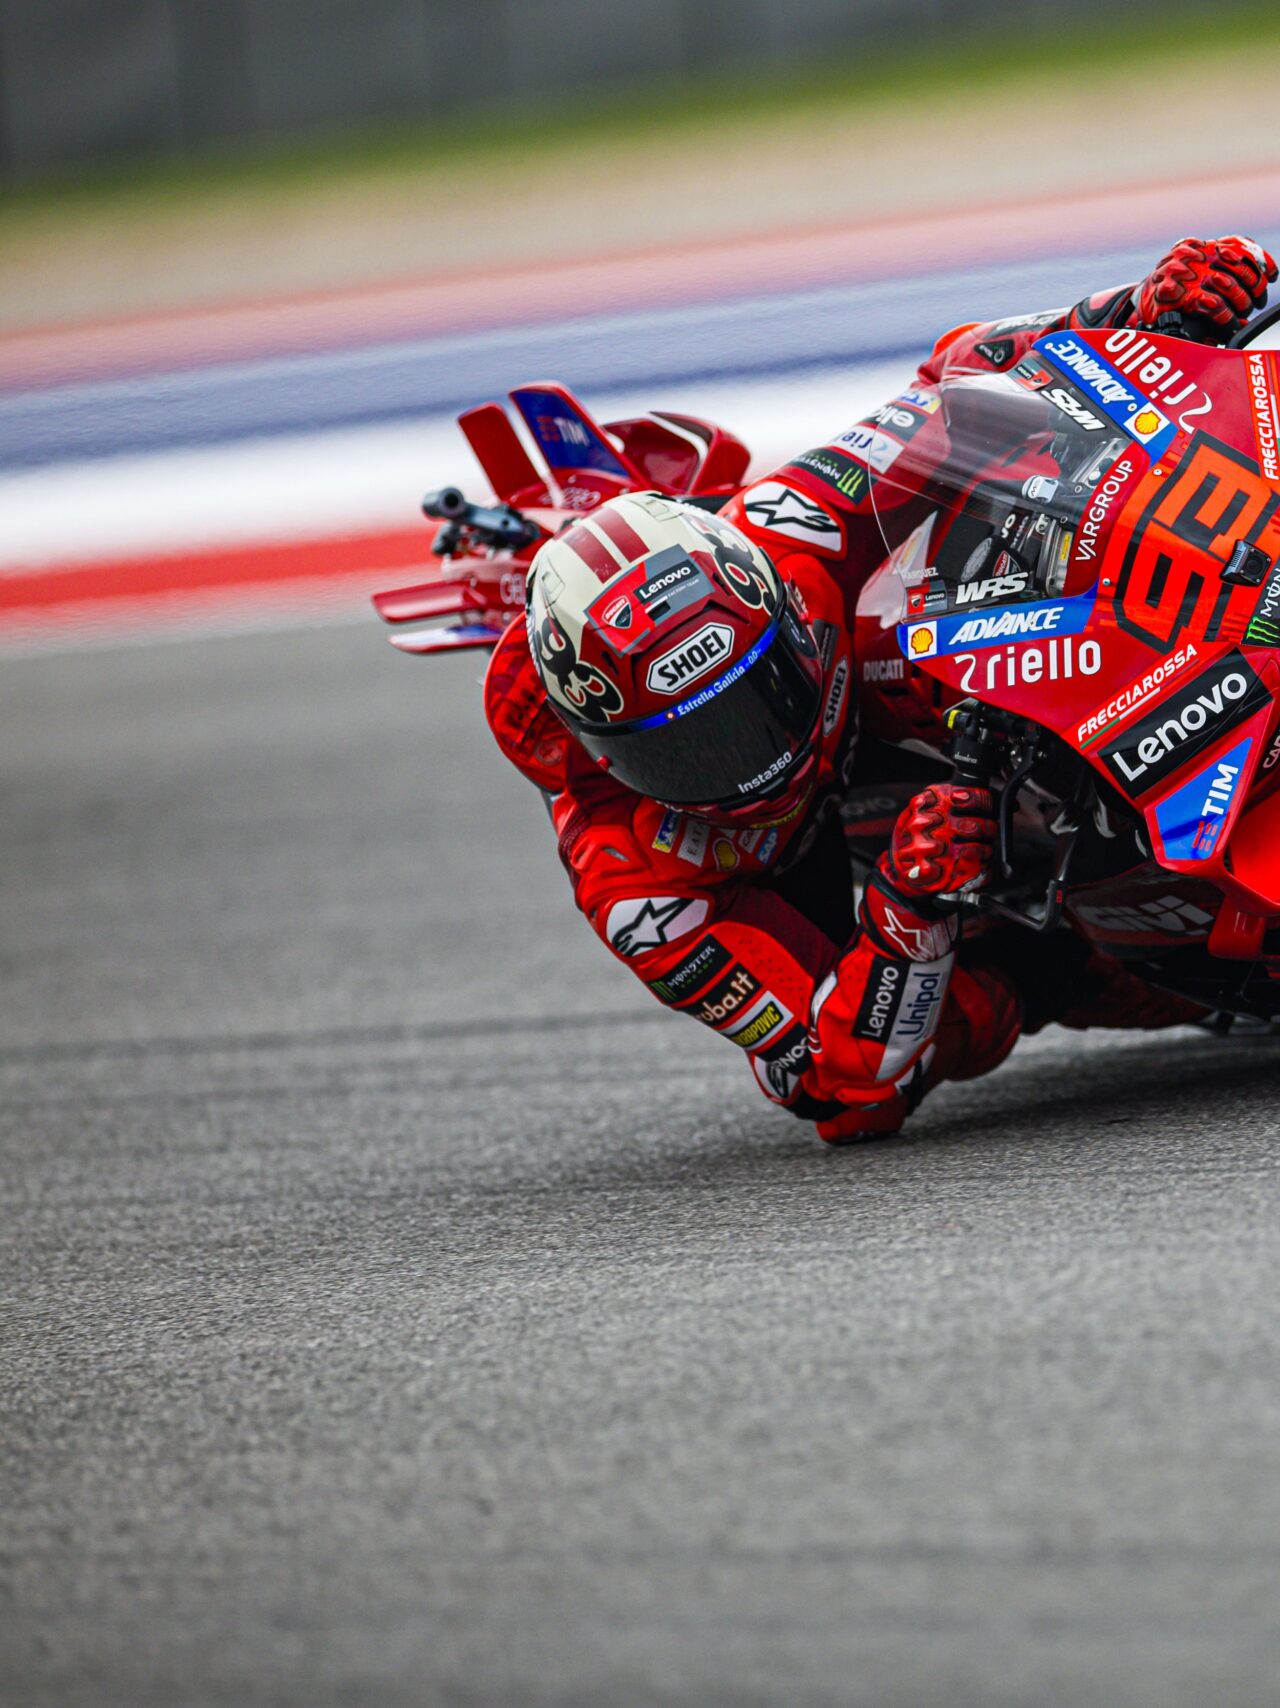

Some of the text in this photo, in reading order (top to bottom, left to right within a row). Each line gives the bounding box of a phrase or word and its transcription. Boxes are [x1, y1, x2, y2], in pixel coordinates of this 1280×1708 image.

[1046, 339, 1136, 405] ADVANCE
[1104, 329, 1197, 406] riello
[1042, 389, 1105, 431] WRS
[1252, 353, 1279, 481] FRECCIAROSSA
[1075, 460, 1135, 562] VARGROUP
[640, 567, 691, 599] Lenovo
[955, 572, 1028, 605] WRS
[949, 607, 1064, 645] ADVANCE
[658, 631, 726, 687] SHOEI
[863, 658, 904, 682] DUCATI
[986, 640, 1101, 690] riello
[677, 691, 715, 716] Estrella
[714, 667, 745, 693] Galicia
[824, 667, 846, 723] SHOEI
[1077, 644, 1197, 742] FRECCIAROSSA
[1112, 673, 1248, 781] Lenovo
[738, 751, 792, 794] Insta360
[1202, 763, 1239, 817] TIM
[697, 971, 754, 1022] uba.it
[861, 966, 899, 1037] Lenovo
[896, 972, 940, 1035] Unipol
